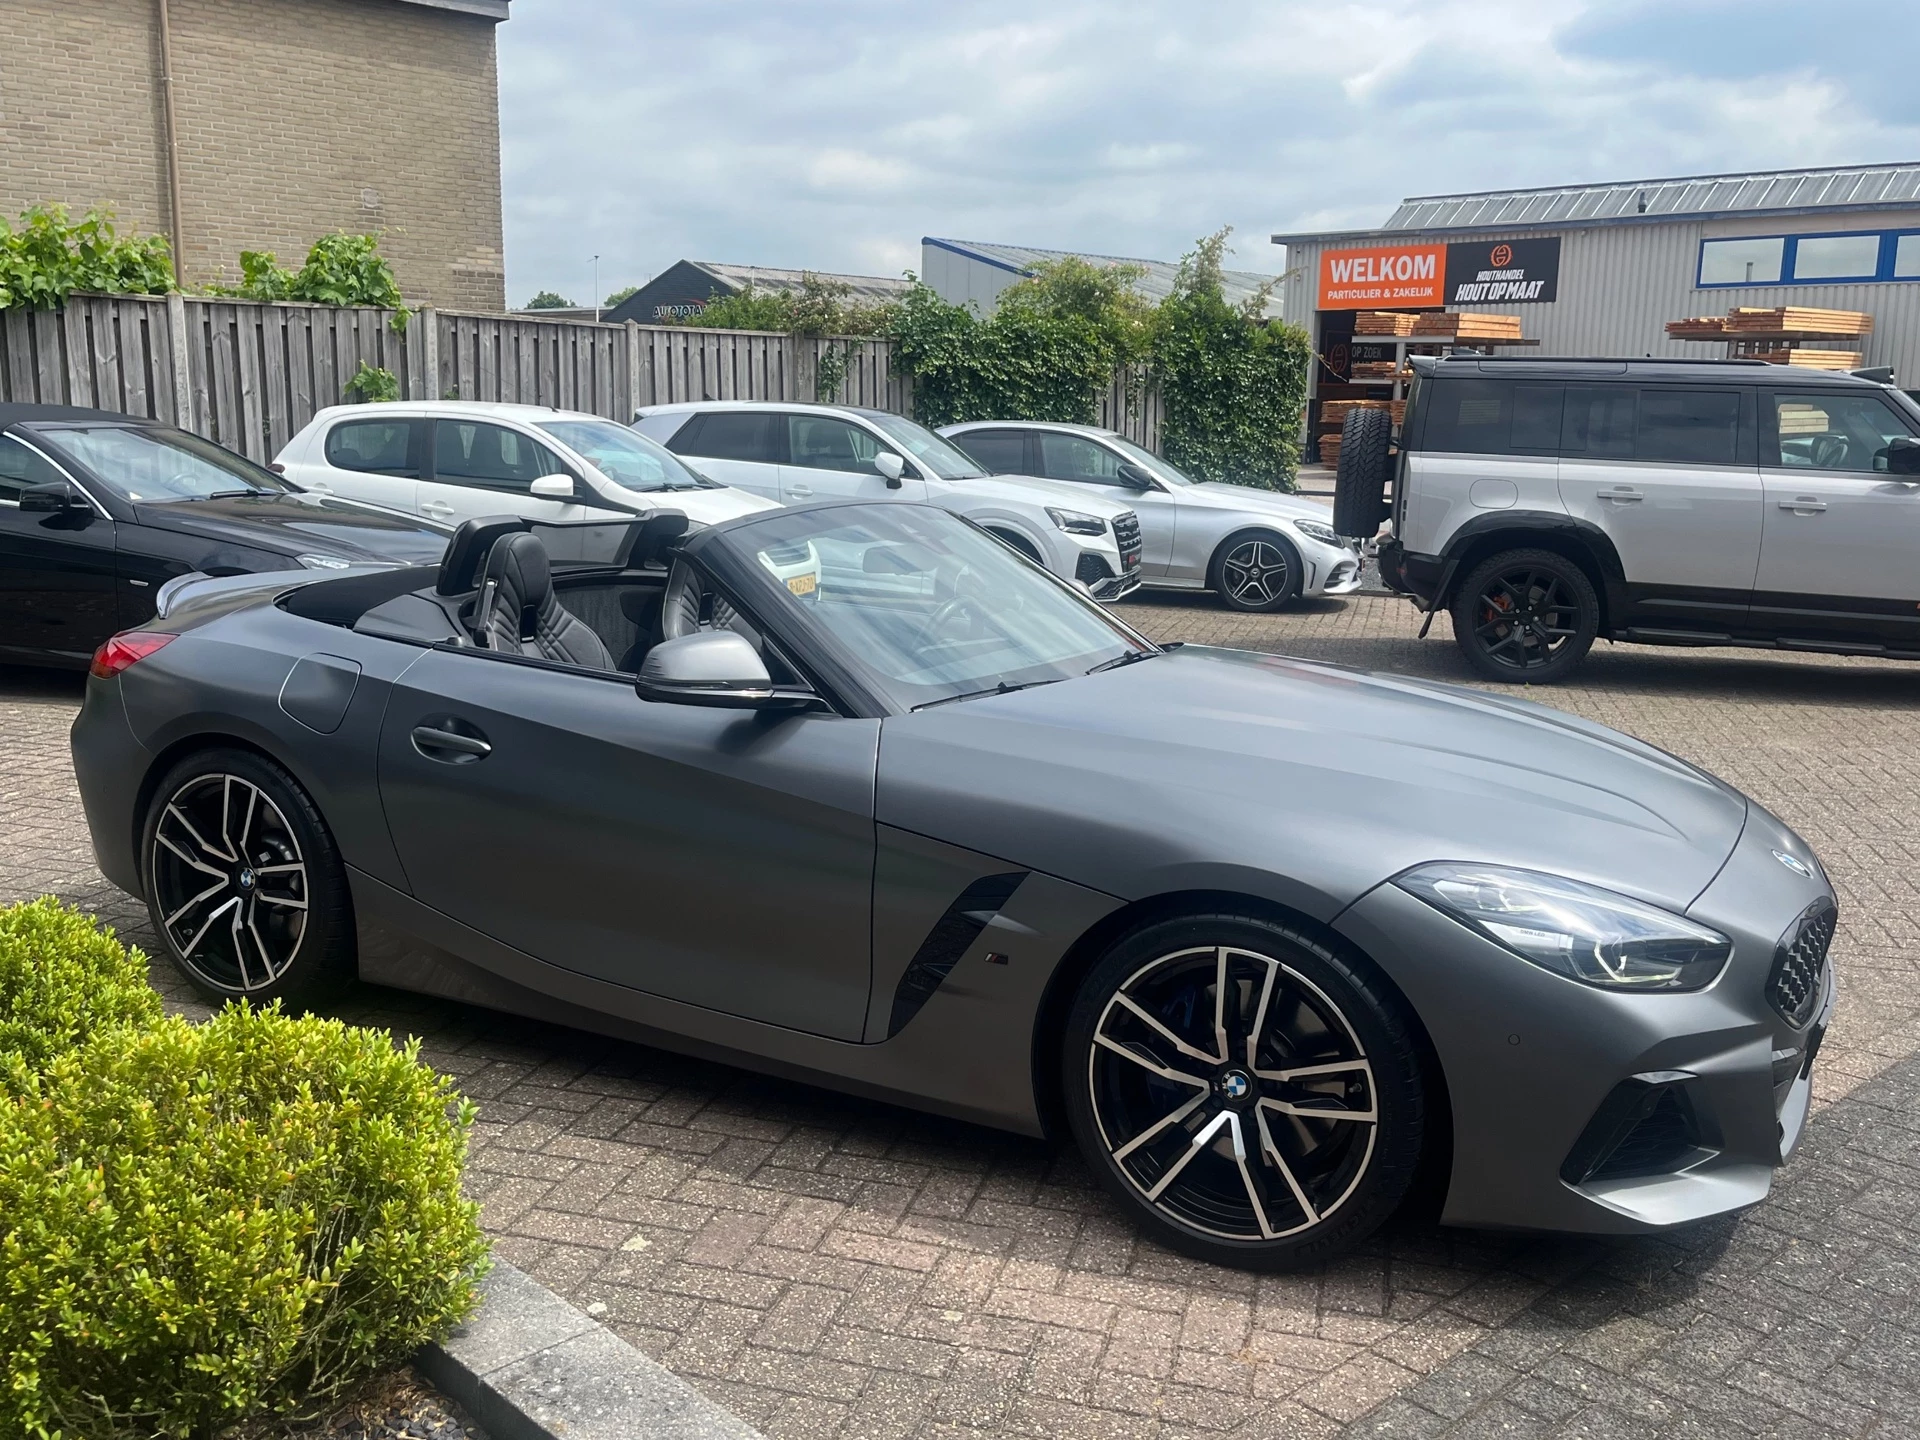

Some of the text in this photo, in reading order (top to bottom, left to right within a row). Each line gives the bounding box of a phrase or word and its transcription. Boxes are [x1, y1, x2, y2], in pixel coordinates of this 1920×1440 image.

[1330, 254, 1436, 283] WELKOM
[1475, 269, 1525, 282] HOUTHANDEL
[1327, 286, 1434, 300] PARTICULIER & ZAKELIJK
[653, 305, 708, 318] AUTOTOTA
[1351, 345, 1382, 359] OP ZOEK
